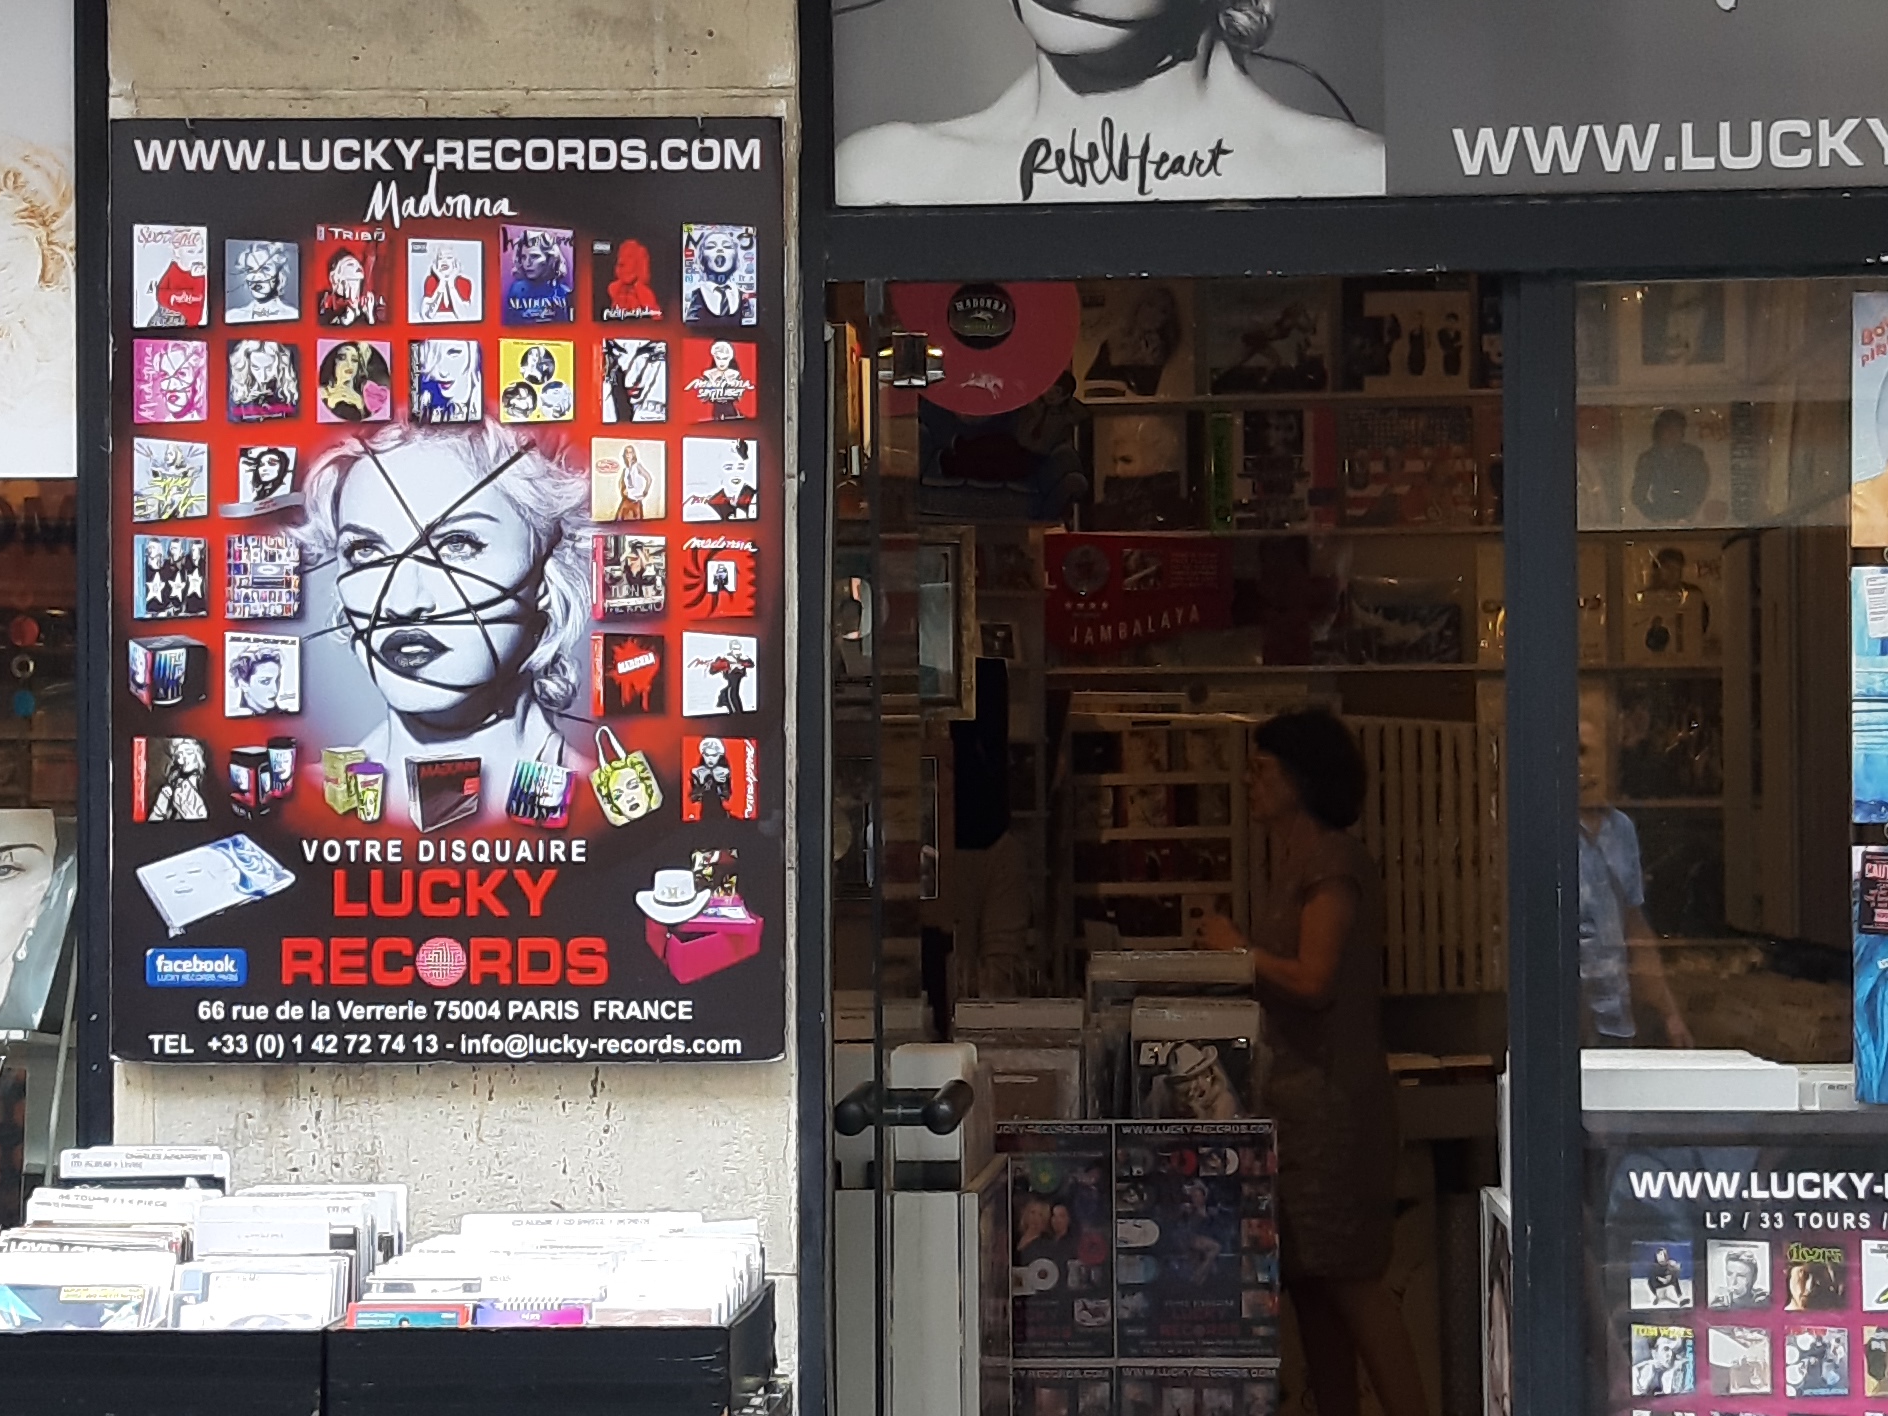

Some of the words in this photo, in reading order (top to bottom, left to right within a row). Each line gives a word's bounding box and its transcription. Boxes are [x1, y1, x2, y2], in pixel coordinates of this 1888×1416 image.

[134, 137, 762, 172] WWW.LUCKY-RECORDS.COM
[363, 167, 518, 229] Madonna
[1069, 602, 1201, 646] JAMBALAYA
[302, 840, 401, 862] VOTRE
[419, 840, 585, 862] DISQUAIRE
[334, 868, 557, 917] LUCKY
[156, 954, 236, 976] facebook
[282, 938, 609, 987] RECORDS
[199, 1001, 224, 1020] 66
[233, 1005, 268, 1020] rue
[276, 1001, 303, 1019] de
[312, 1000, 330, 1020] la
[337, 1000, 427, 1020] Verrerie
[434, 1000, 501, 1020] 75004
[509, 1000, 579, 1020] PARIS
[594, 1000, 692, 1020] FRANCE
[148, 1034, 194, 1054] TEL
[208, 1034, 248, 1053] +33
[256, 1034, 284, 1058] (0)
[292, 1034, 301, 1053] 1
[311, 1035, 337, 1053] 42
[344, 1034, 372, 1054] 72
[378, 1034, 405, 1054] 74
[412, 1034, 438, 1054] 13
[461, 1034, 741, 1058] info@lucky-records.com
[1706, 1212, 1731, 1228] LP
[1760, 1213, 1783, 1228] 33
[1795, 1212, 1870, 1230] TOURS
